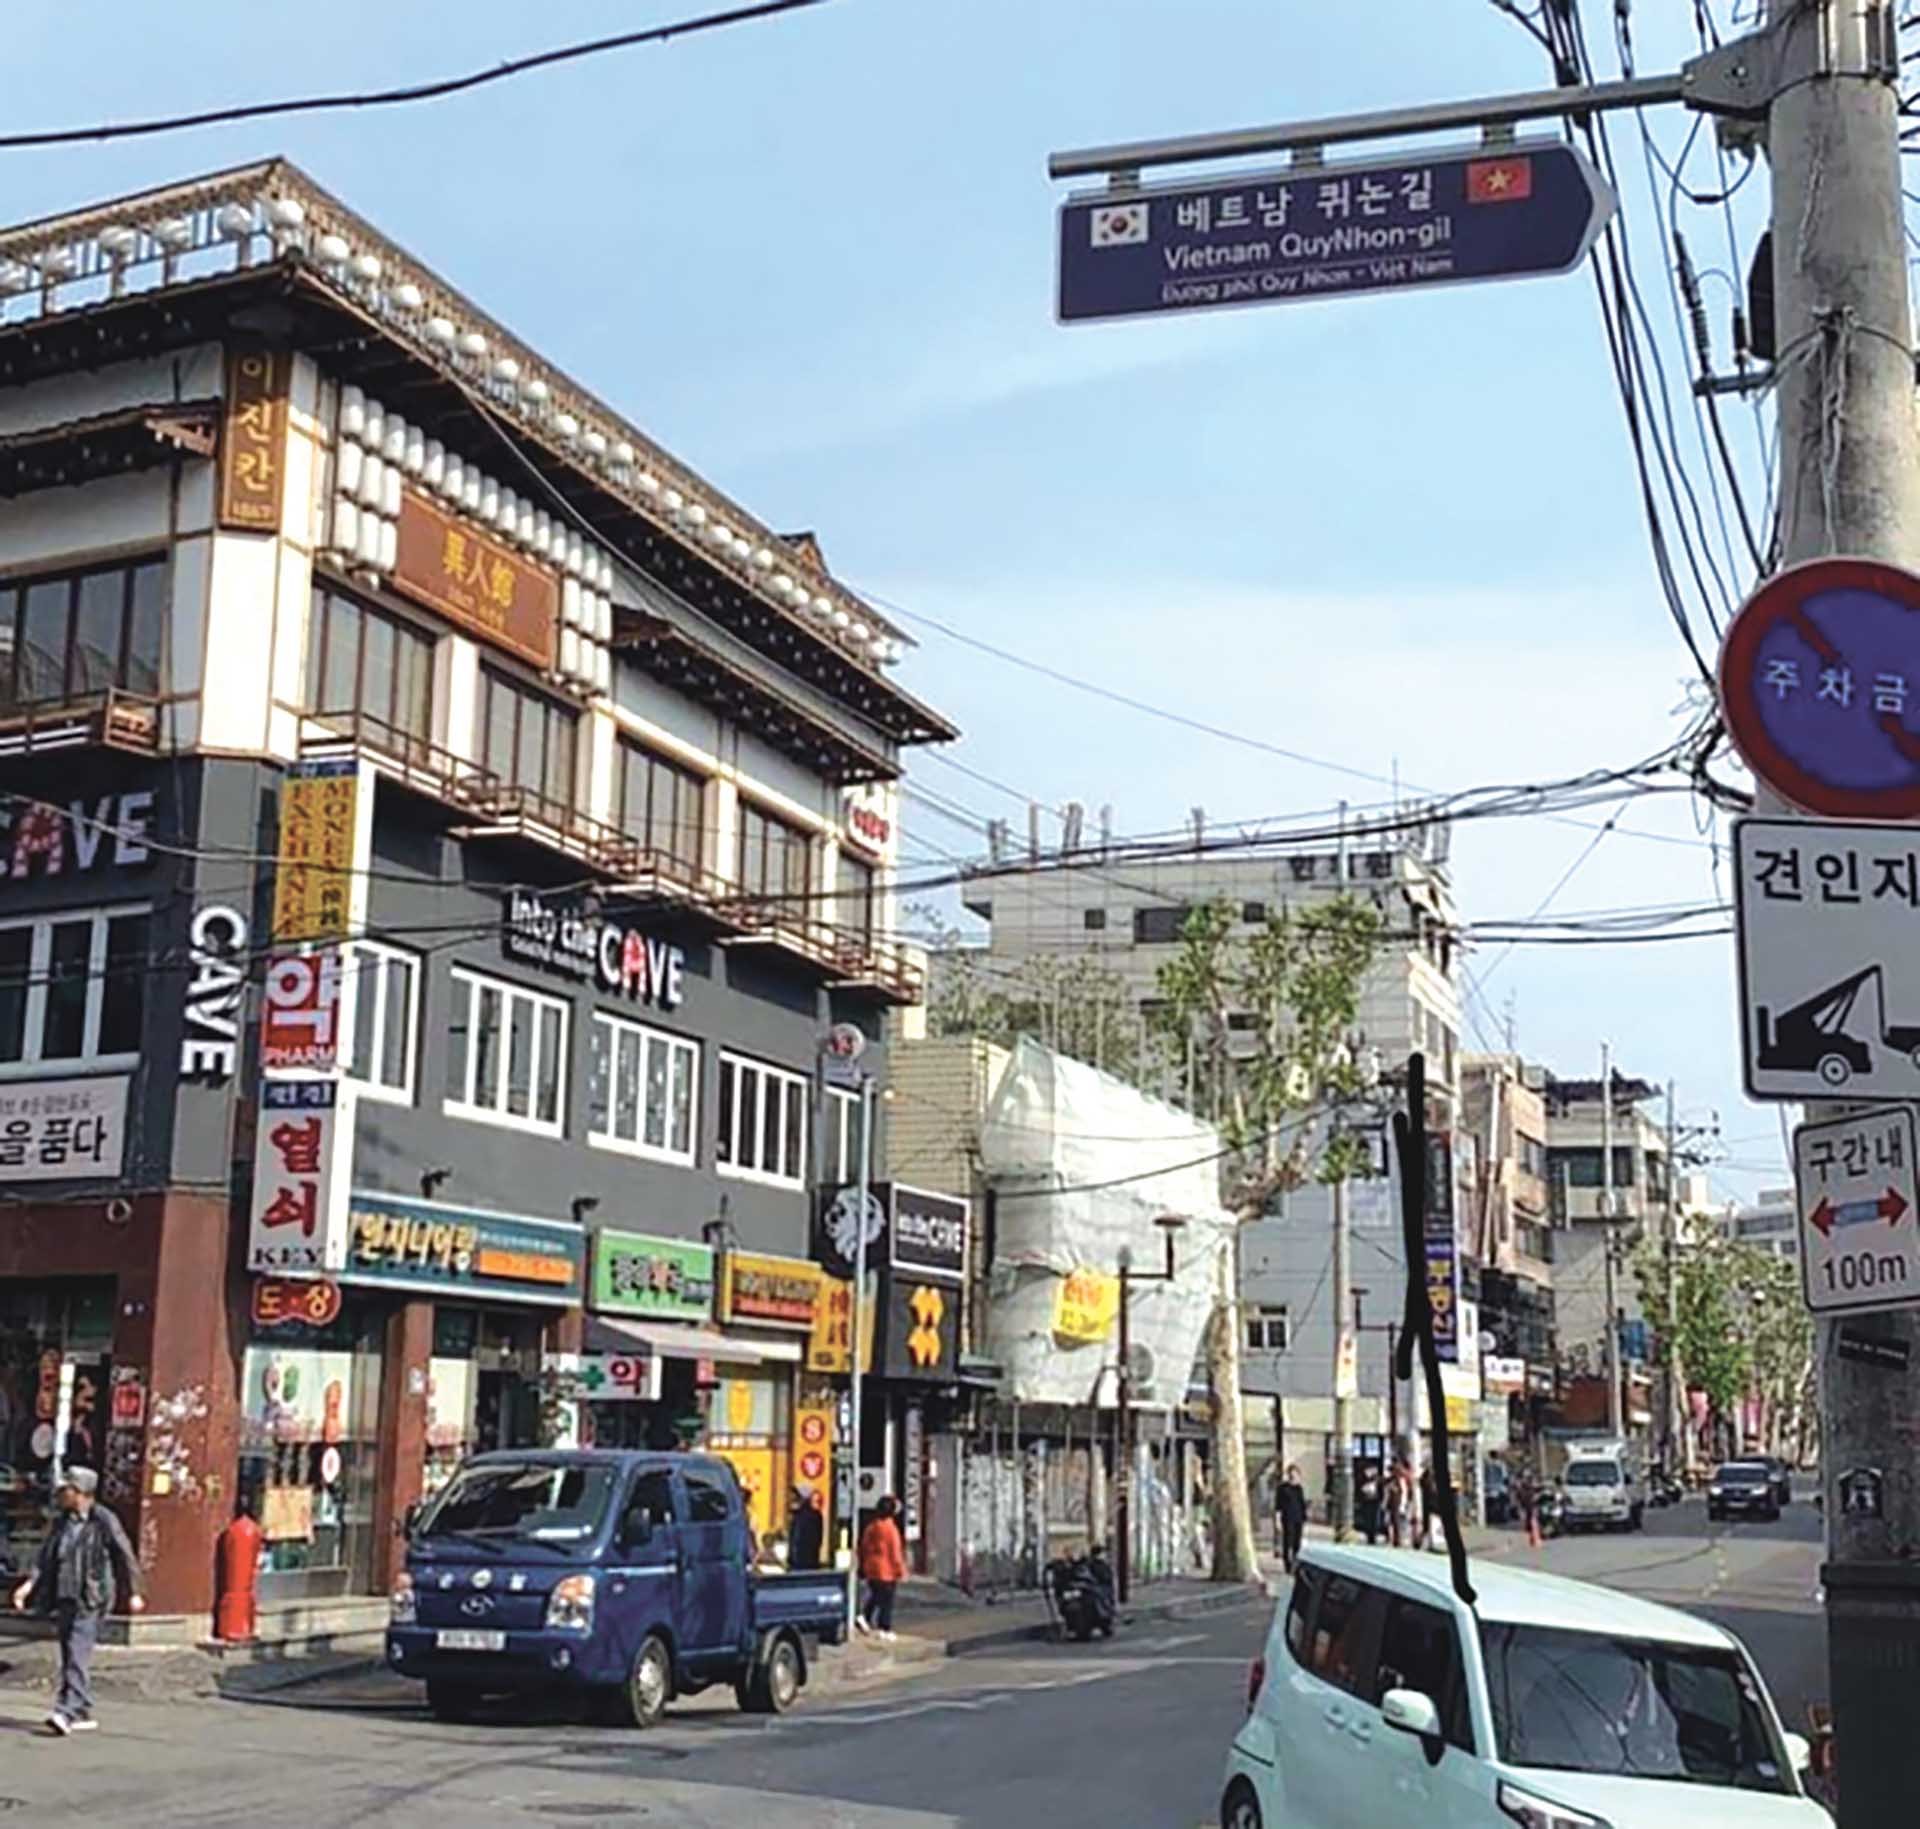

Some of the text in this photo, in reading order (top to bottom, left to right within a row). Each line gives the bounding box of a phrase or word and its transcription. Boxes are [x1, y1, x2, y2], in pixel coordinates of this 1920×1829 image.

[1177, 170, 1433, 233] 베트남 퀴논길
[1164, 217, 1451, 271] Vietnam QuyNhon-gil
[1764, 658, 1920, 714] 주차금
[0, 792, 153, 878] AVE
[180, 905, 247, 1075] CAVE
[600, 924, 685, 1004] CAVE
[265, 948, 341, 1045] 약
[261, 1115, 322, 1238] 열쇠
[1809, 1130, 1903, 1184] 구간내
[253, 1247, 324, 1265] KEY
[1823, 1252, 1907, 1292] 100m
